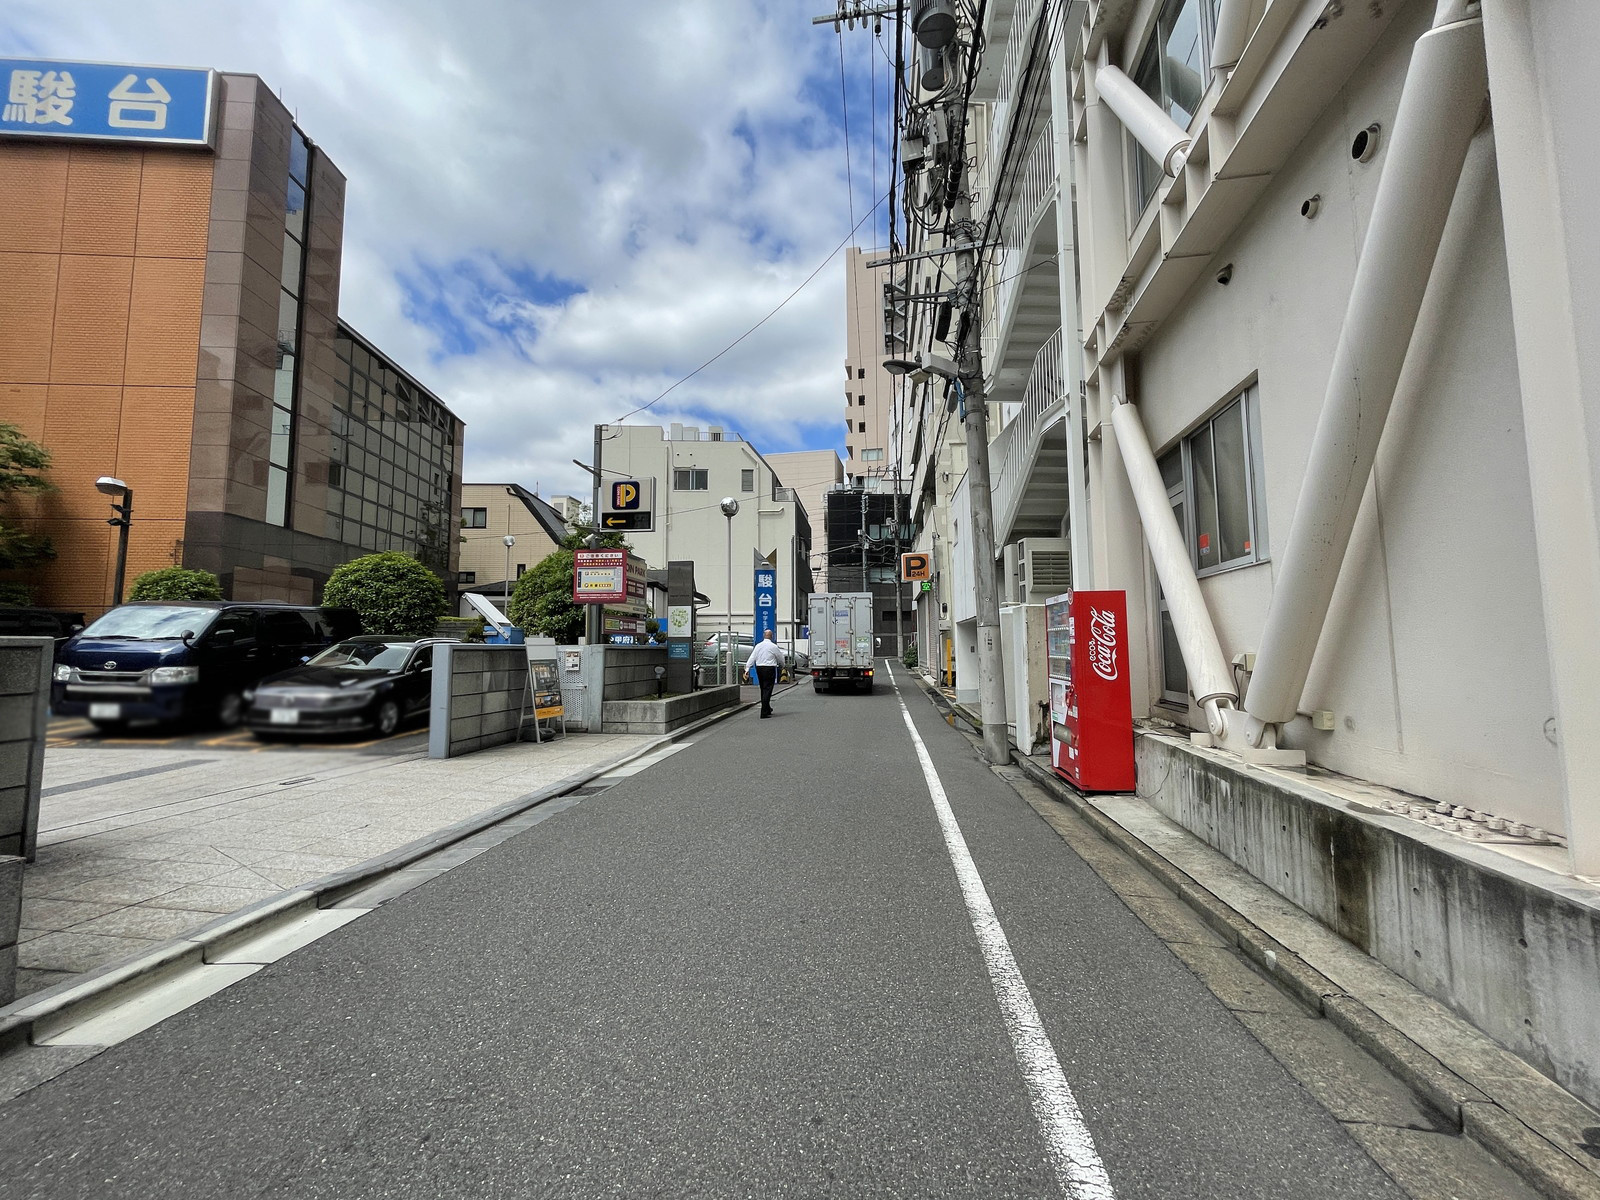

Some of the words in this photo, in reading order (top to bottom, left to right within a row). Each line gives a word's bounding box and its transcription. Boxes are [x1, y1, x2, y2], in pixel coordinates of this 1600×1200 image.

[2, 69, 172, 130] 駿台
[620, 484, 636, 507] P
[905, 556, 926, 577] P
[757, 574, 773, 607] 駿台
